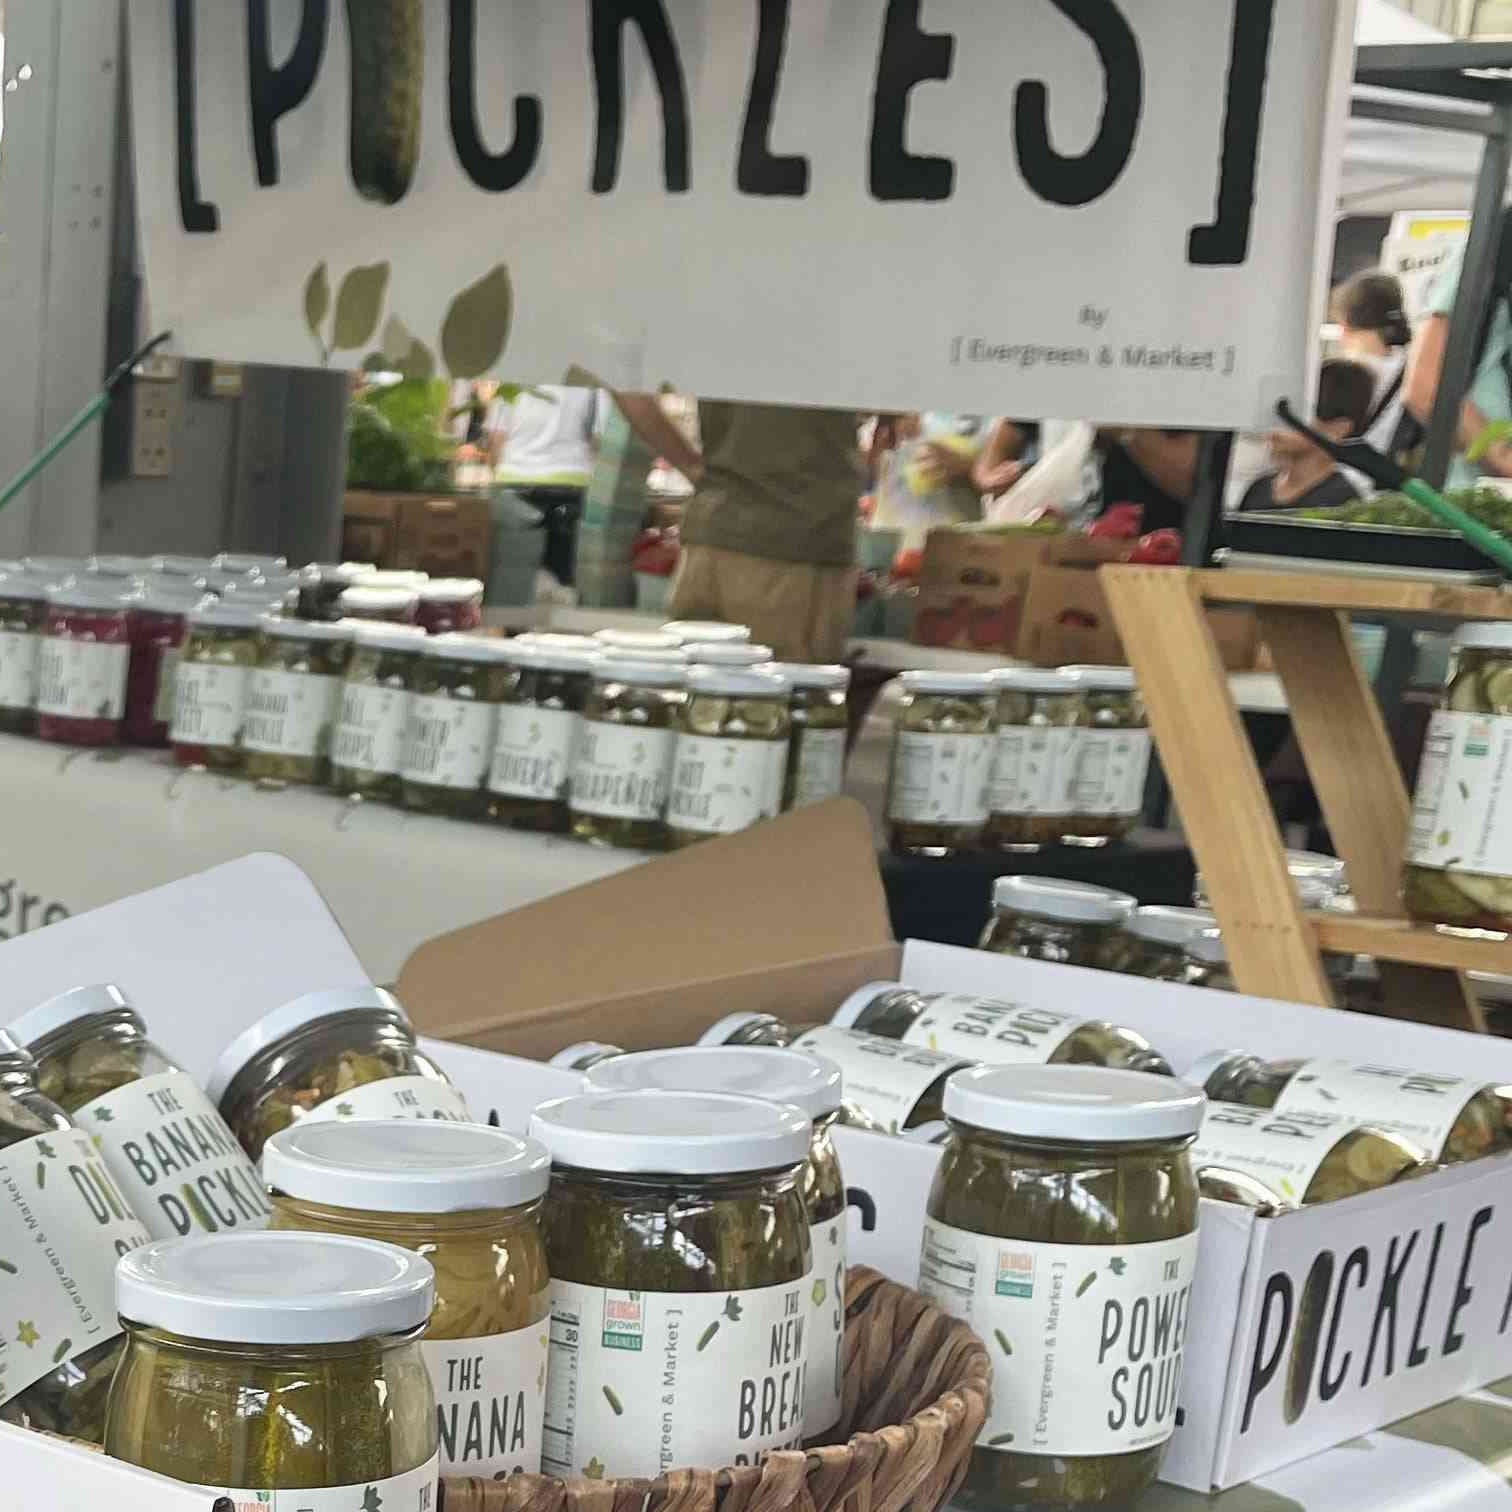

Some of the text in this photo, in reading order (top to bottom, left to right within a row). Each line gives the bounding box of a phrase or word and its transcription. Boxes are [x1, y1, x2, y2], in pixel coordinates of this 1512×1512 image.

[147, 1087, 183, 1116] THE
[784, 1290, 800, 1317] THE
[1240, 1204, 1495, 1435] PICKLE
[447, 1356, 484, 1392] THE
[663, 1320, 681, 1387] Market
[769, 1315, 805, 1368] NEW
[1035, 1353, 1056, 1434] Evergreen
[1046, 1274, 1065, 1330] Market
[437, 1391, 525, 1463] NANA
[738, 1360, 807, 1440] BREA
